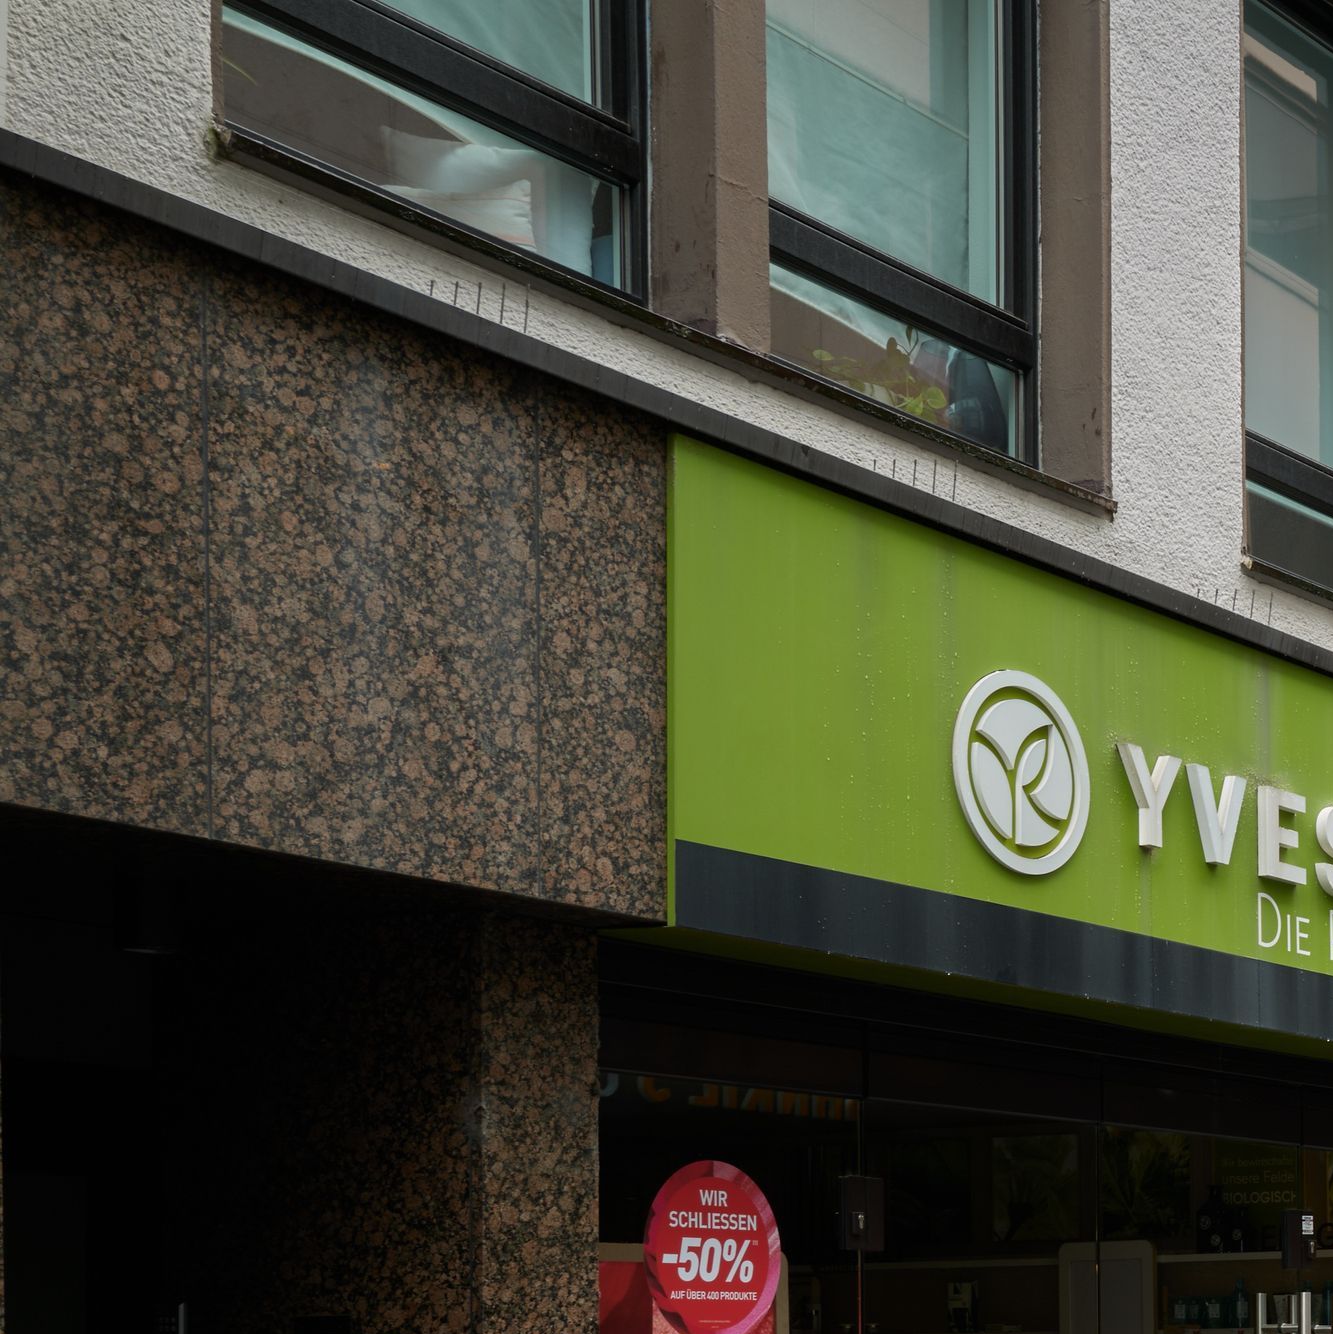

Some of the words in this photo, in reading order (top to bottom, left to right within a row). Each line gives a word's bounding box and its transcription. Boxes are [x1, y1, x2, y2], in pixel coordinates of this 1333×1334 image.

[700, 1189, 728, 1207] WIR
[669, 1211, 757, 1231] SCHLIESSEN
[662, 1236, 754, 1283] -50%
[670, 1290, 685, 1300] AUF
[686, 1289, 706, 1300] ÜBER
[720, 1291, 758, 1301] PRODUKTE
